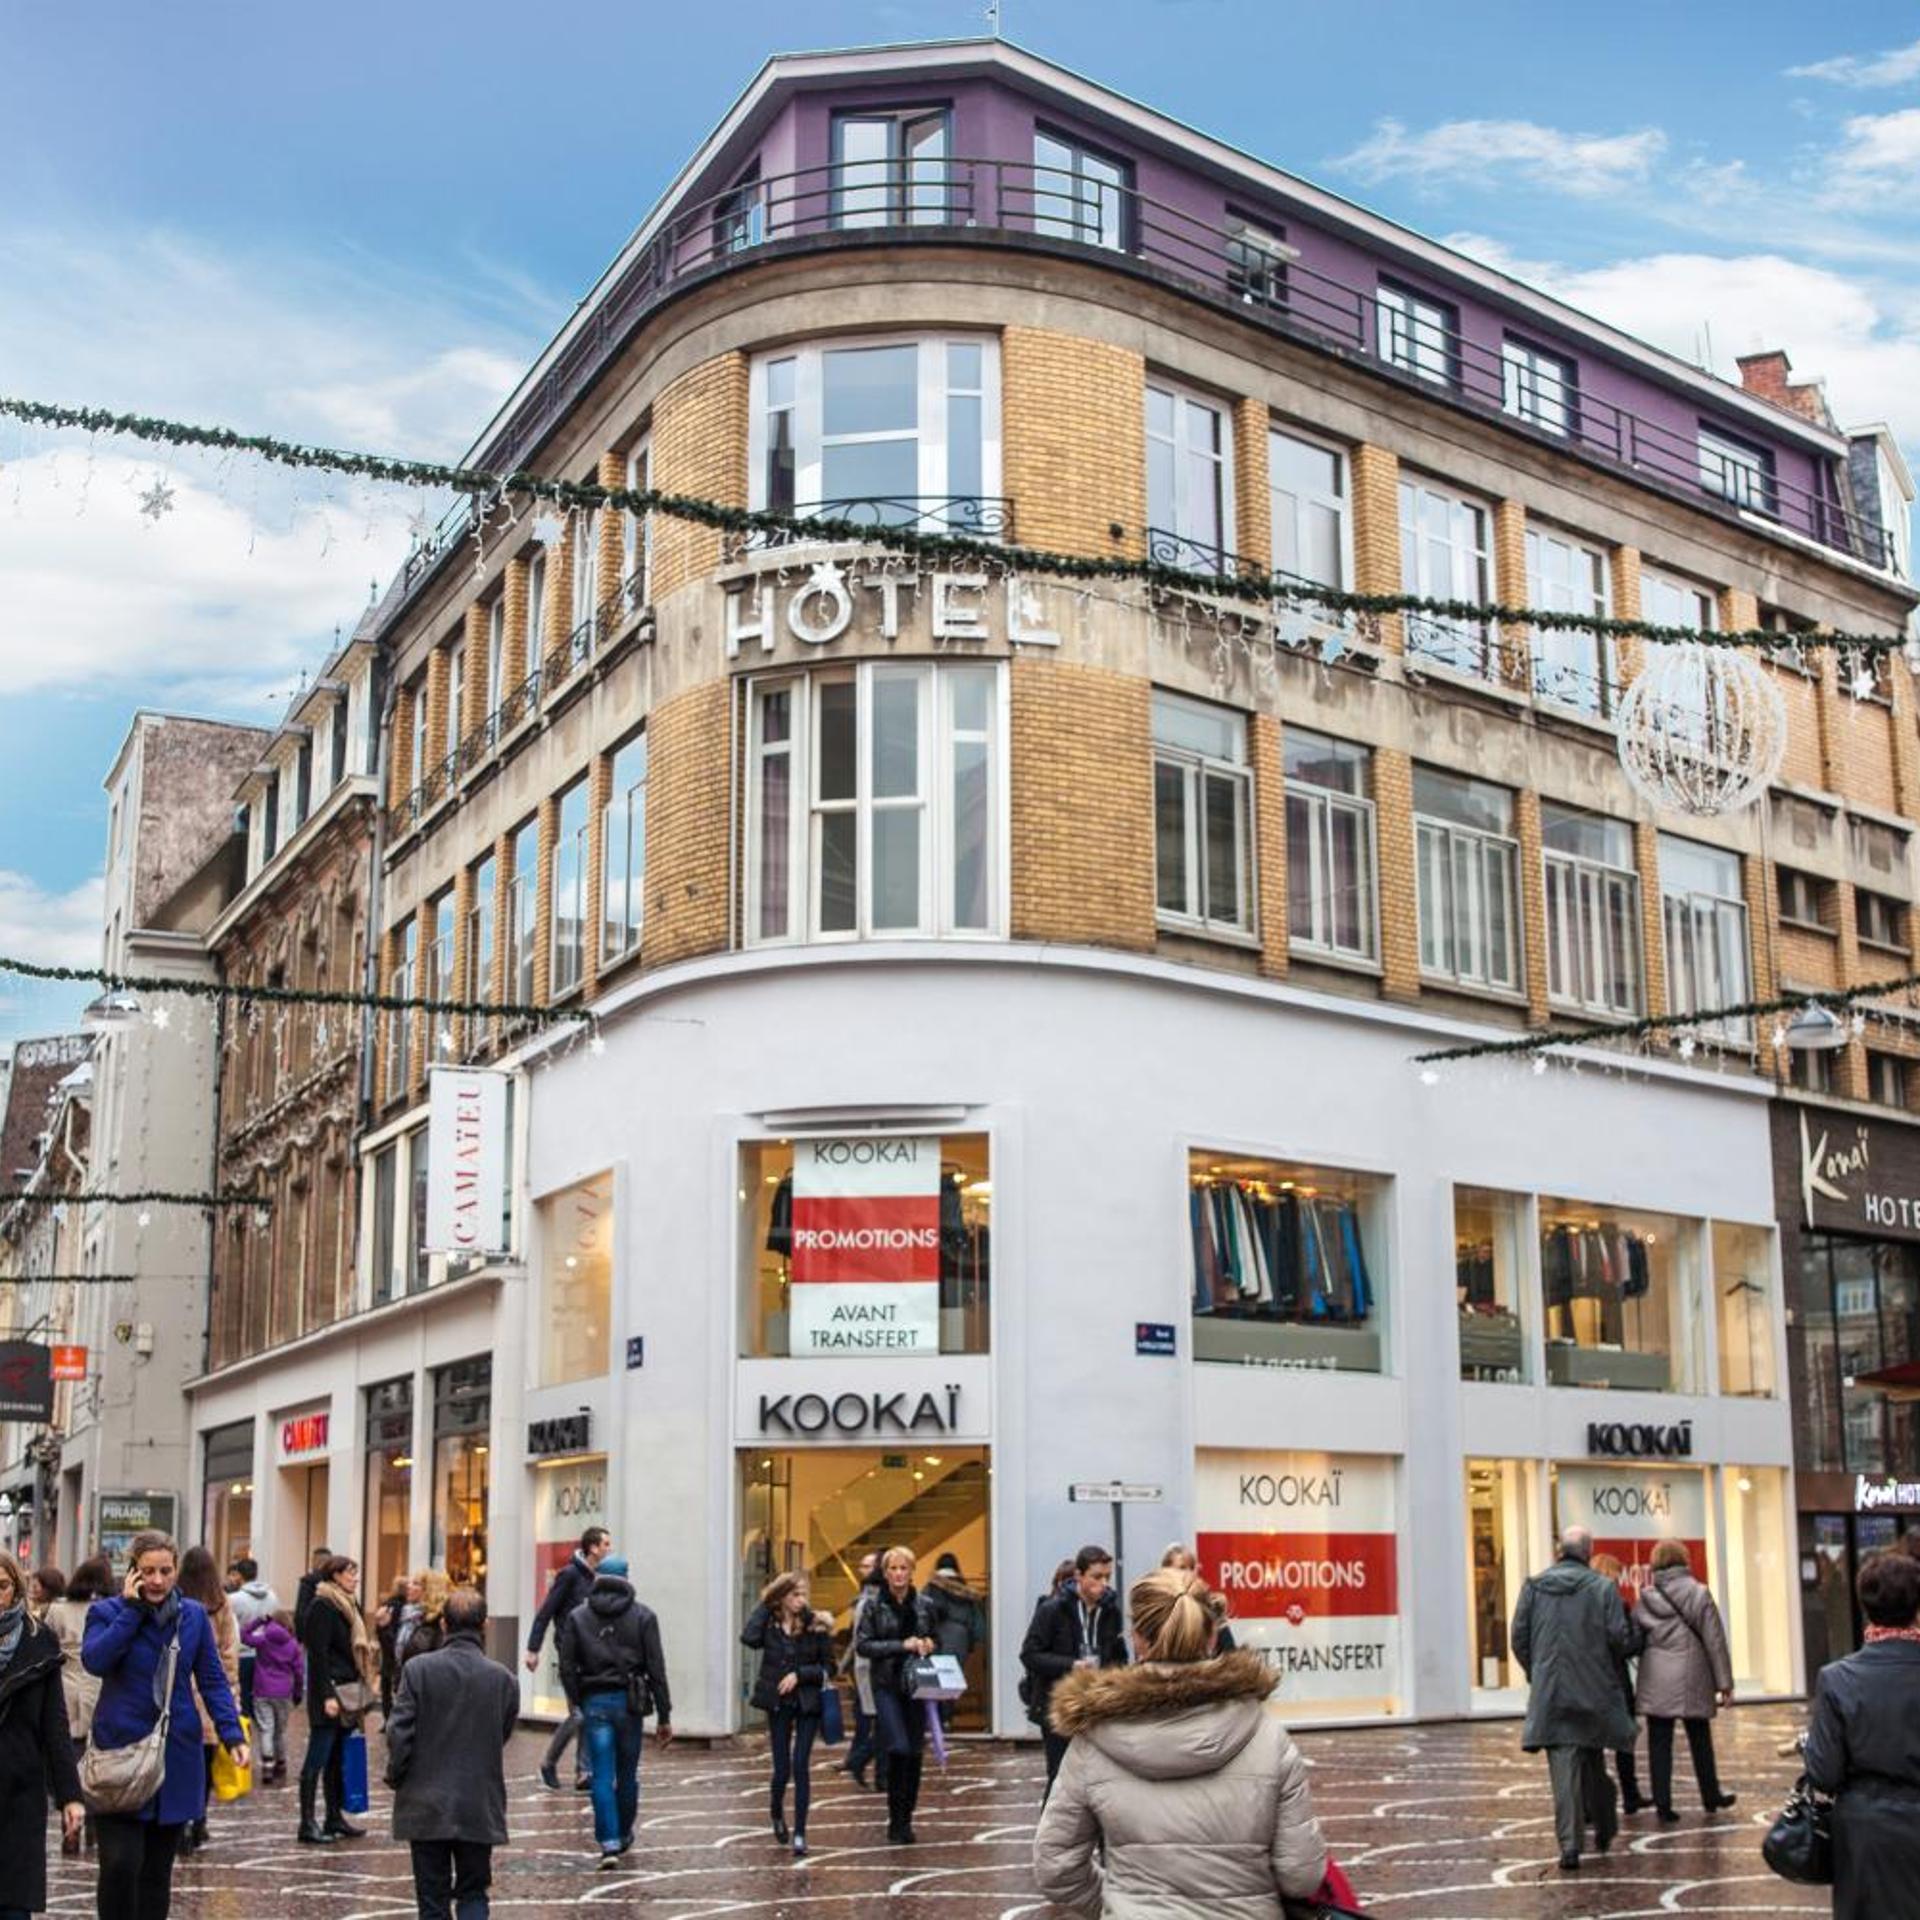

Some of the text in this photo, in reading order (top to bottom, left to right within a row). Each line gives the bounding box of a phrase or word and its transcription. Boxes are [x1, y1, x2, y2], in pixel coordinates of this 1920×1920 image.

[726, 573, 1061, 659] HOTEL
[454, 1079, 481, 1243] CAMAÏEU
[1800, 1108, 1869, 1229] Kanaï
[794, 1228, 938, 1249] PROMOTIONS
[831, 1304, 897, 1322] AVANT
[810, 1330, 919, 1348] TRANSFERT
[759, 1384, 961, 1432] KOOKAÏ
[1587, 1420, 1693, 1456] KOOKAÏ
[1239, 1469, 1343, 1506] KOOKAÏ
[1592, 1483, 1671, 1516] KOOKAÏ
[1219, 1560, 1366, 1589] PROMOTIONS
[1279, 1644, 1386, 1673] TRANSFERT
